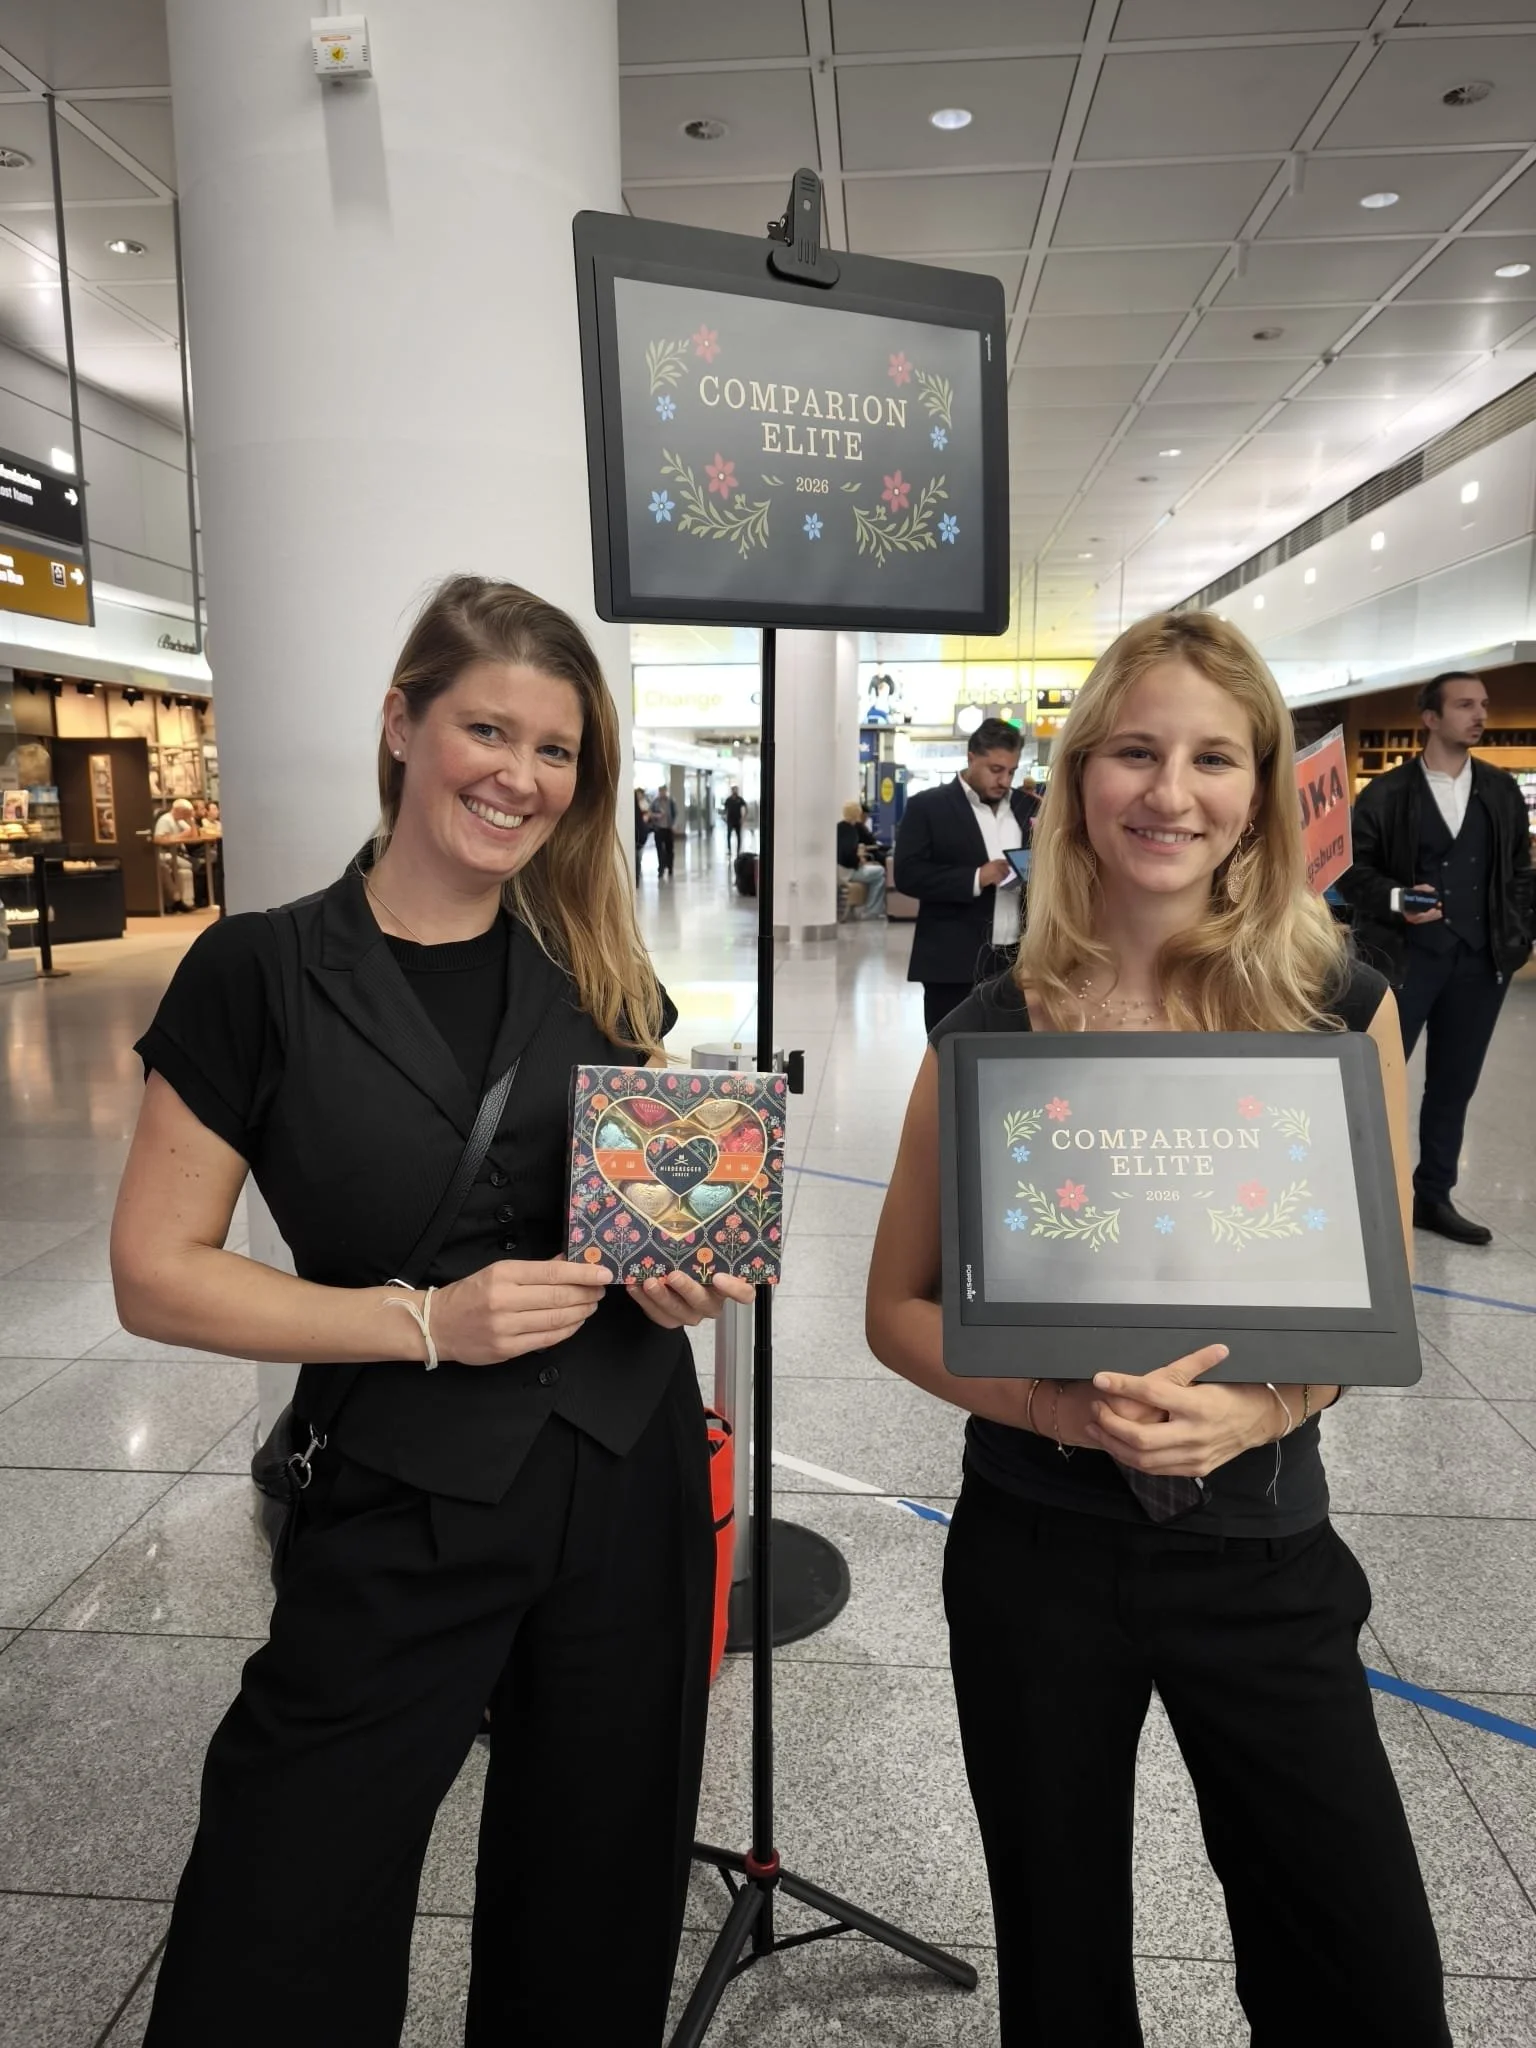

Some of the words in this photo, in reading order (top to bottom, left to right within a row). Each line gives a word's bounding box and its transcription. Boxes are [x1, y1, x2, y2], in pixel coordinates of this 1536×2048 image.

[699, 375, 908, 428] COMPARION
[761, 422, 863, 461] ELITE
[796, 476, 829, 494] 2026
[644, 689, 723, 712] Change
[1306, 834, 1344, 884] gsburg
[1051, 1128, 1260, 1150] COMPARION
[1110, 1155, 1215, 1176] ELITE
[1145, 1190, 1180, 1201] 2026
